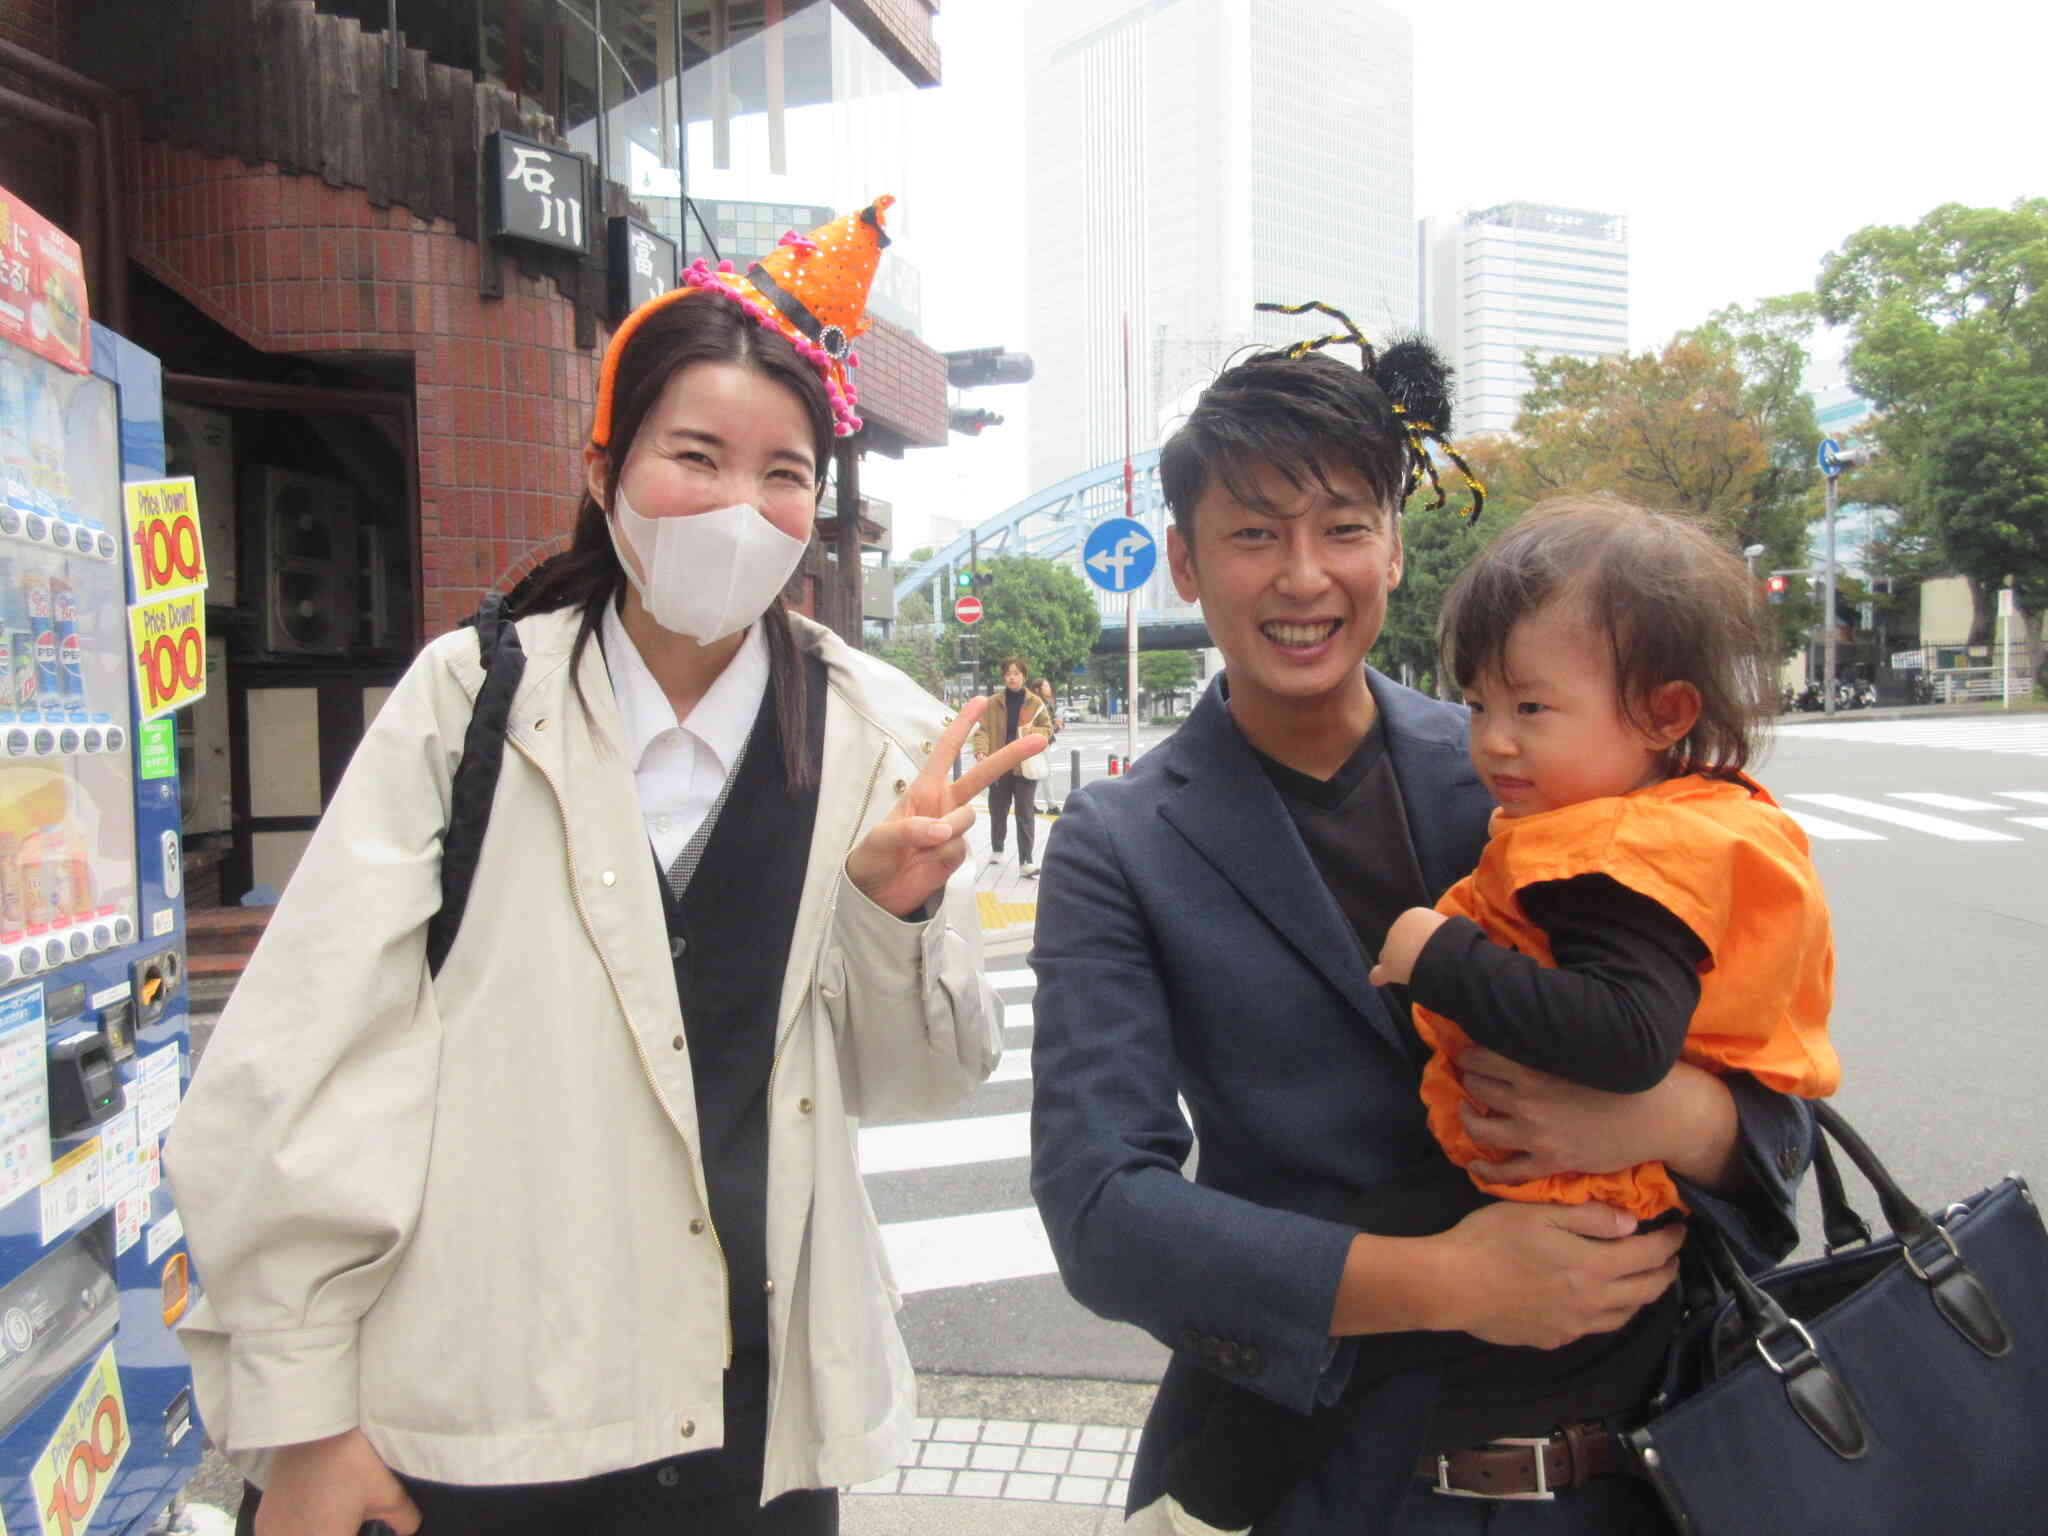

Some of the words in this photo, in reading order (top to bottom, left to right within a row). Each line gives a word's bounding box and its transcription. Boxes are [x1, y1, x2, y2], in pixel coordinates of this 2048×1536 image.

[506, 147, 582, 246] 石川
[137, 490, 161, 516] Price
[160, 486, 189, 513] Down!
[134, 515, 202, 590] 100
[143, 610, 167, 636] Price
[167, 598, 196, 629] Down!
[139, 626, 203, 708] 100
[47, 1394, 122, 1536] 100
